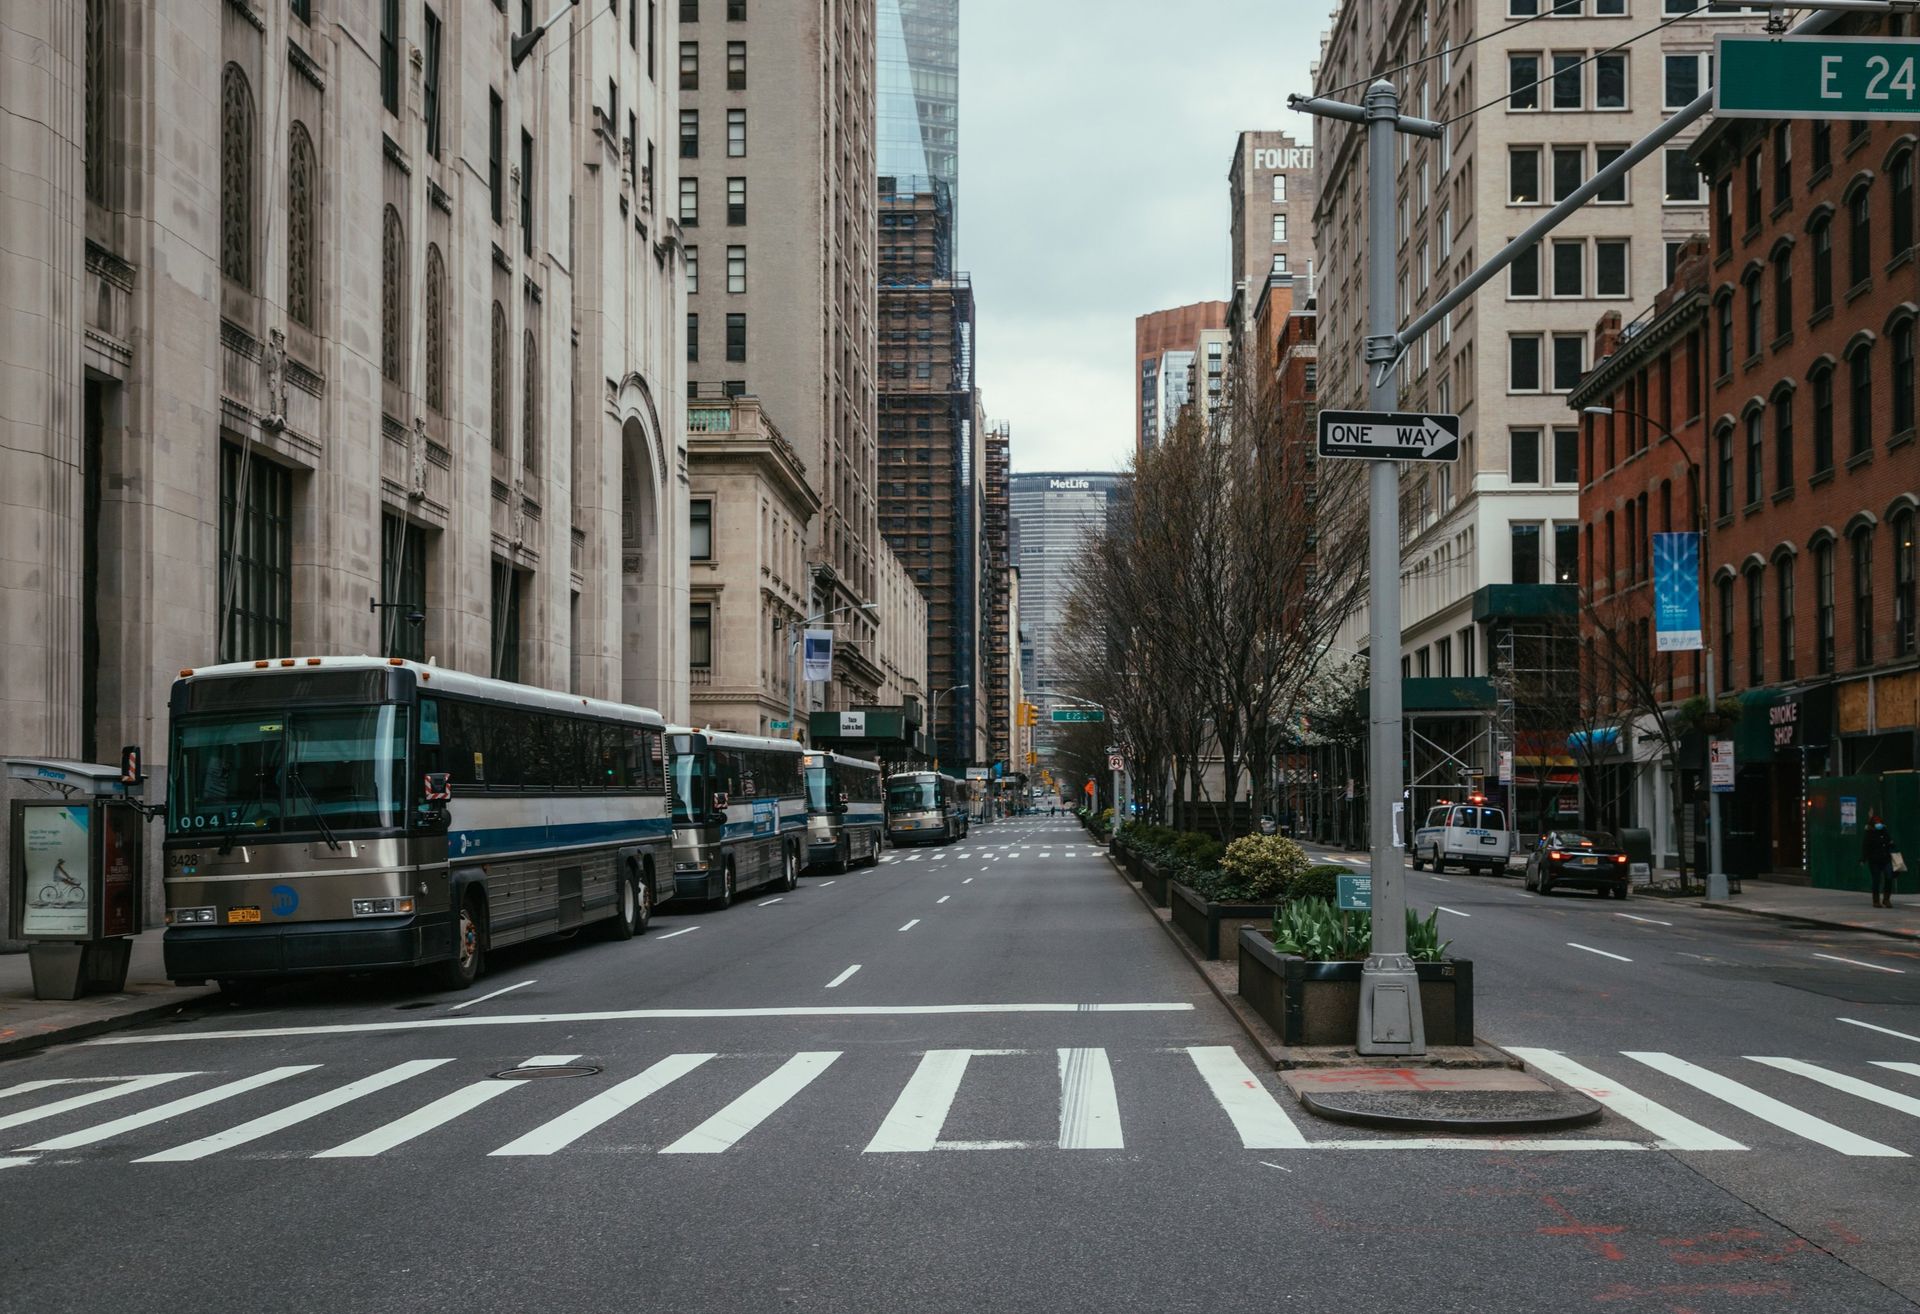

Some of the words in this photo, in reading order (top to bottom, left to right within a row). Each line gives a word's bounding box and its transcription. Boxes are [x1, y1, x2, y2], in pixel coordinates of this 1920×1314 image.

[1821, 55, 1843, 99] E
[1864, 55, 1916, 101] 24
[1332, 425, 1373, 444] ONE
[1396, 427, 1440, 446] WAY
[1050, 479, 1089, 489] MetLife
[1769, 702, 1797, 725] SMOKE
[1774, 725, 1793, 745] SHOP
[37, 767, 66, 780] Phone
